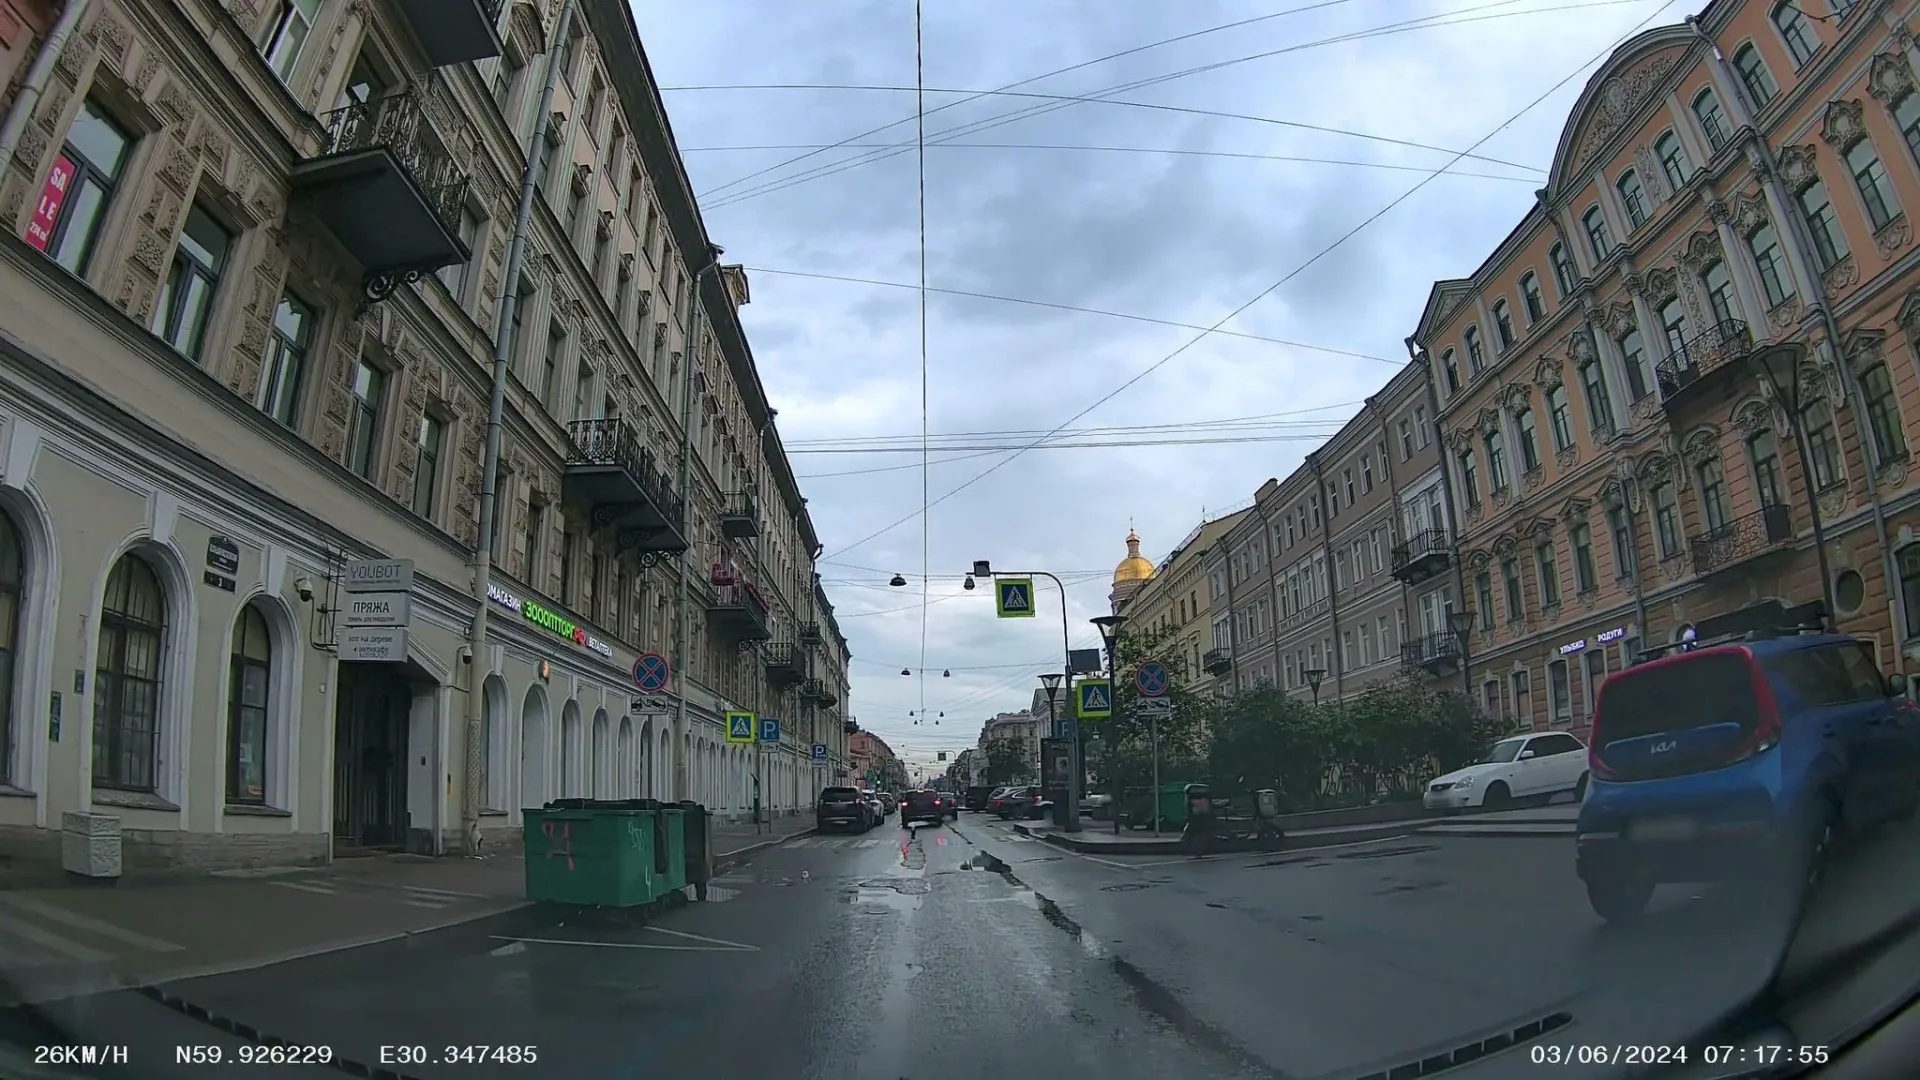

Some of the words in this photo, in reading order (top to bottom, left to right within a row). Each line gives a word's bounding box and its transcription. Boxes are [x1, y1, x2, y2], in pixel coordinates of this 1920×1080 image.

[350, 564, 402, 579] YOUBOT
[353, 601, 390, 613] ПРЯЖА
[763, 721, 776, 738] P
[1650, 740, 1677, 754] KIA
